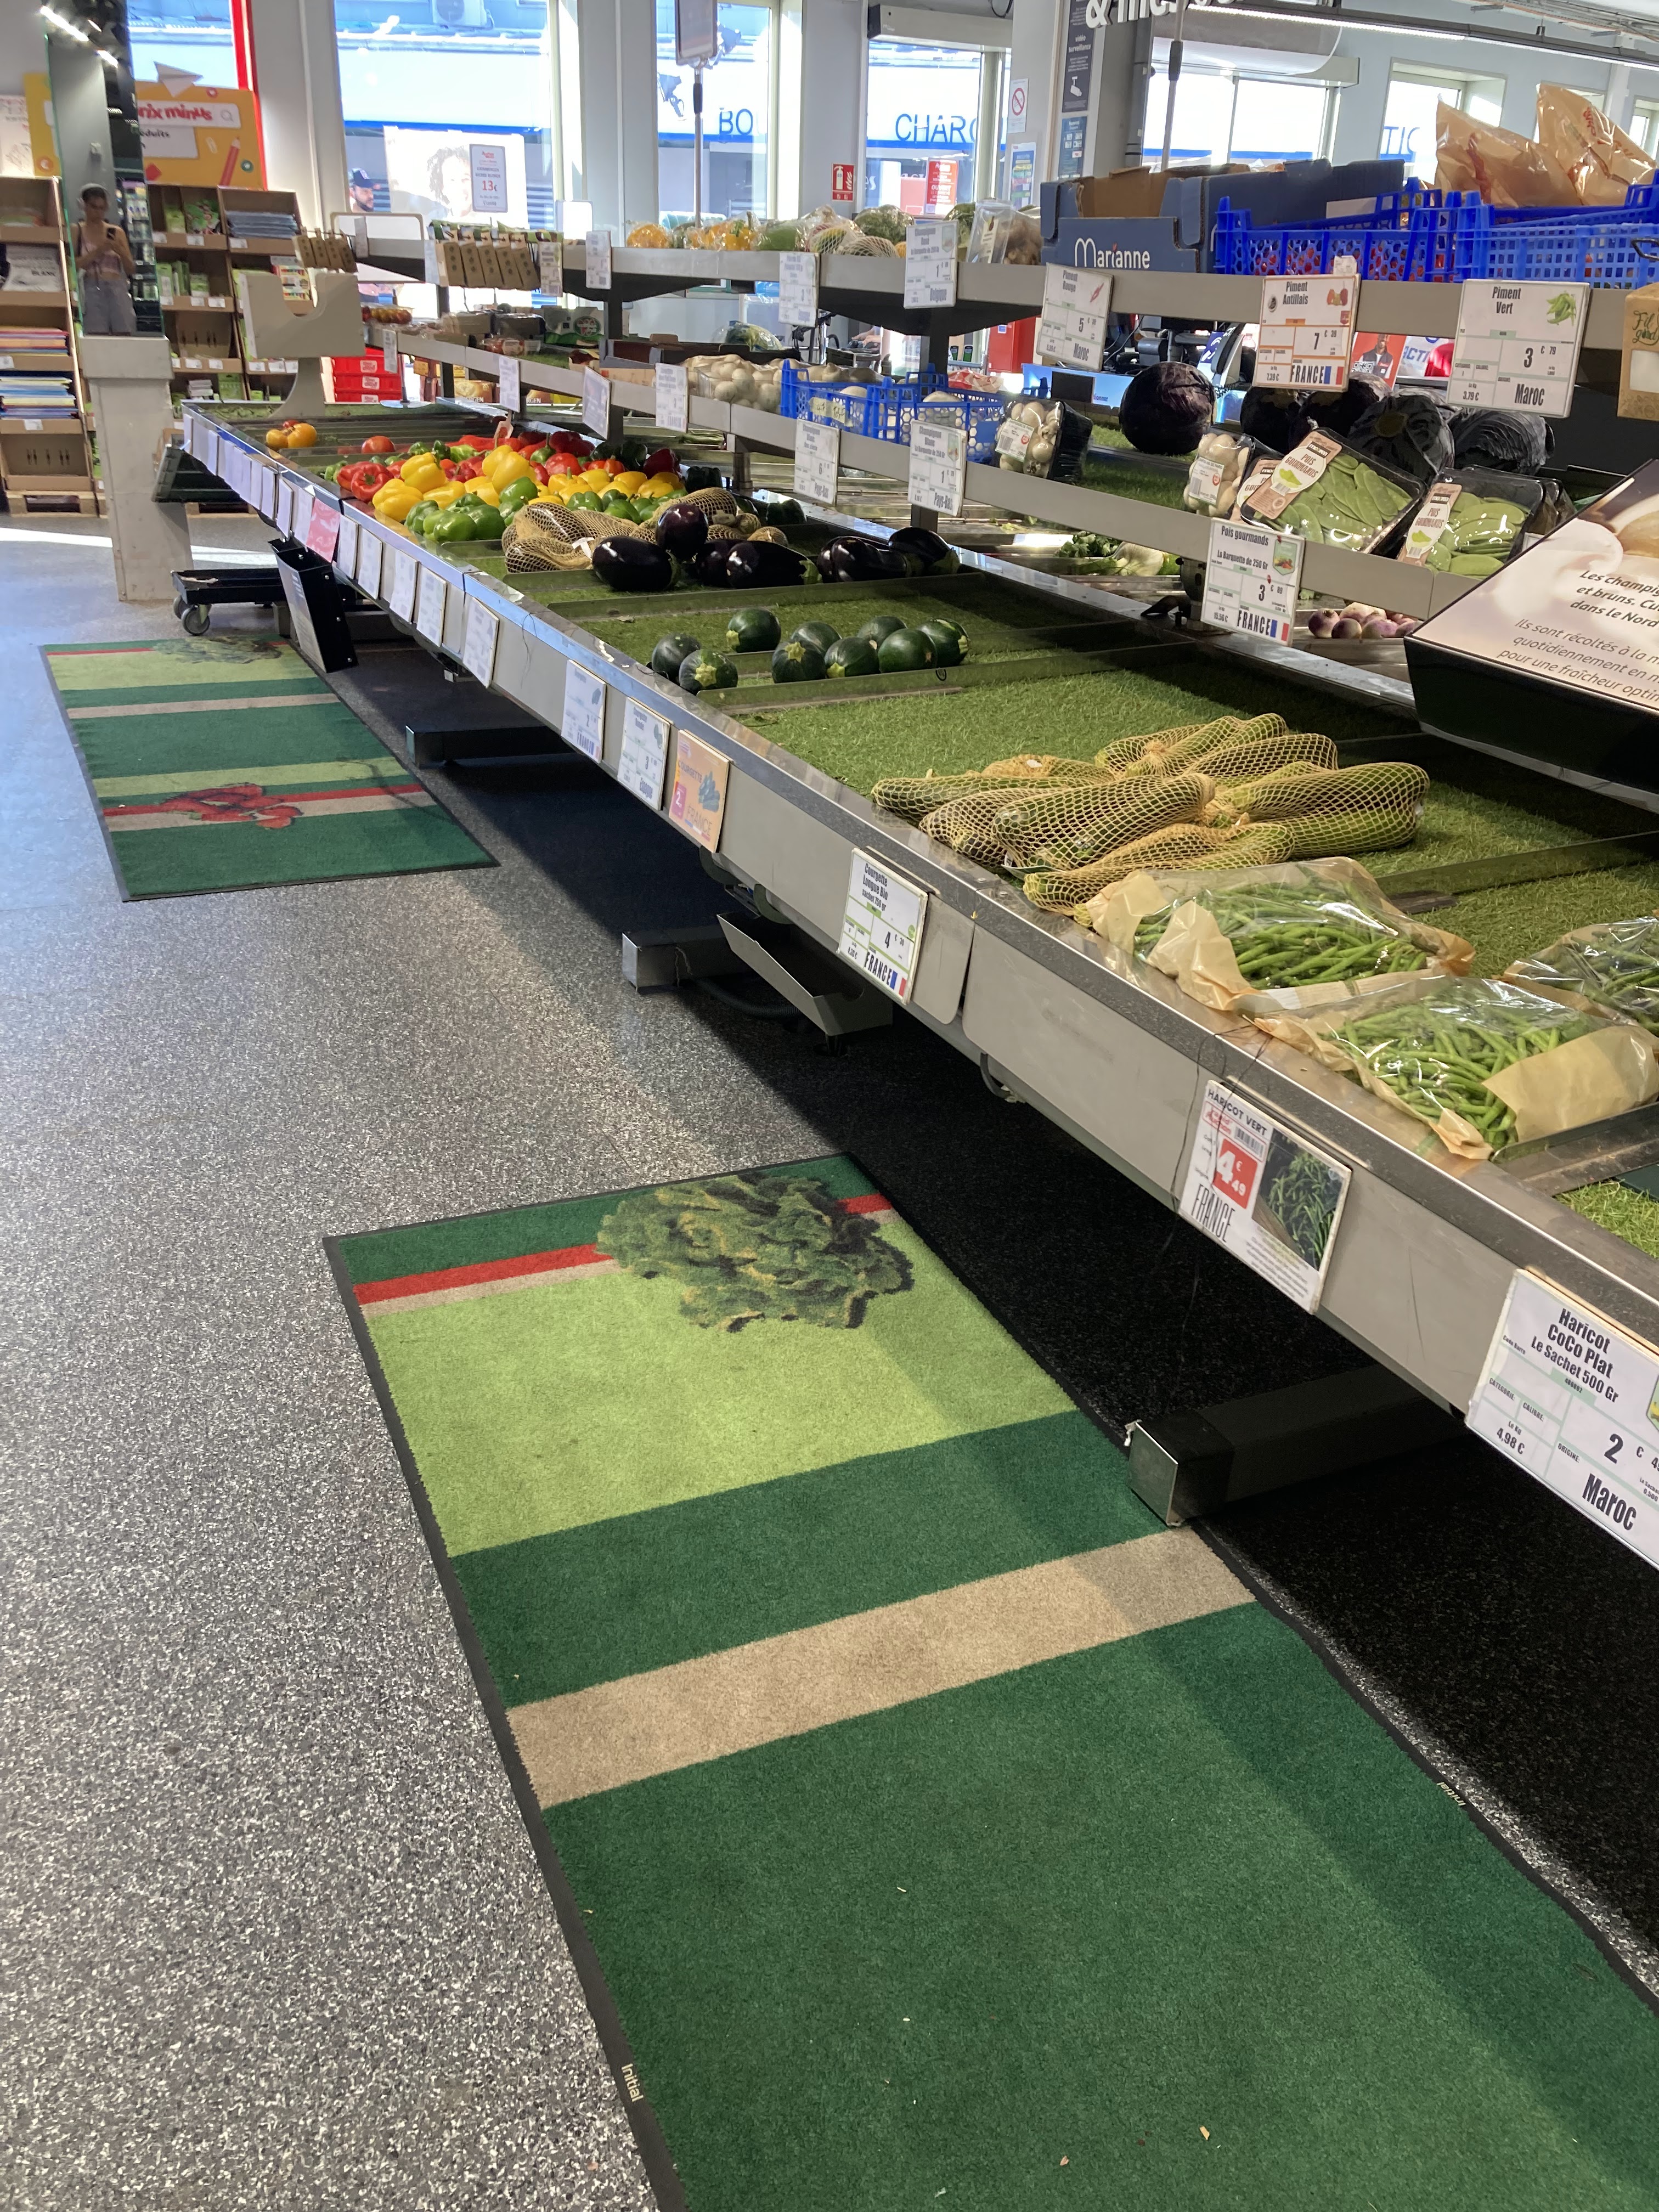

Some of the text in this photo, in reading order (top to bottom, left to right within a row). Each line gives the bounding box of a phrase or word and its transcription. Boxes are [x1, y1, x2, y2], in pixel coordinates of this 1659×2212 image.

[1074, 238, 1150, 269] Marianne
[1063, 269, 1078, 282] Piment
[1062, 280, 1076, 293] Rouge
[1285, 281, 1308, 292] Piment
[1492, 286, 1521, 300] Piment
[1283, 294, 1308, 305] Antillais
[1496, 301, 1514, 315] Vert
[1079, 318, 1085, 332] 5
[1313, 332, 1319, 350] 7
[1073, 342, 1090, 362] Maroc
[1523, 347, 1533, 368] 3
[1549, 346, 1556, 355] 79
[1290, 365, 1324, 384] FRANCE
[1514, 383, 1545, 406] Maroc
[919, 425, 942, 439] Champignon
[819, 462, 823, 475] 6
[1284, 456, 1319, 478] GOURMANDS
[1300, 453, 1317, 466] POIS
[941, 470, 945, 483] 1
[934, 492, 953, 510] Pays-Bas
[1221, 525, 1269, 546] Pois gourmands
[1217, 549, 1222, 558] La
[1223, 551, 1246, 565] Barquette
[1246, 556, 1252, 566] de
[1252, 558, 1262, 568] 250
[1262, 561, 1268, 570] Gr
[1579, 570, 1605, 582] Les
[1259, 584, 1266, 601] 3
[1577, 586, 1593, 595] et
[1592, 588, 1635, 605] bruns.
[1237, 610, 1271, 636] FRANCE
[1570, 600, 1659, 628] dans le Nord
[1514, 618, 1533, 629] Ils
[1532, 624, 1564, 638] sont
[1564, 633, 1618, 652] récoltés
[1618, 646, 1630, 656] à
[1630, 648, 1646, 661] la
[1513, 636, 1628, 673] quotidiennement
[1628, 668, 1647, 679] en
[1497, 650, 1622, 690] pour une fraîcheur
[645, 756, 649, 770] 3
[678, 759, 703, 783] COURGETTE
[675, 791, 681, 807] 2
[687, 805, 713, 836] FRANCE
[865, 862, 888, 888] Courgette
[862, 873, 888, 901] Longue Bio
[884, 931, 891, 949] 4
[864, 951, 892, 986] FRANCE
[1208, 1088, 1267, 1136] HARICOT VERT
[1216, 1150, 1246, 1197] 4 € 49
[1190, 1183, 1236, 1243] FRANCE
[1558, 1307, 1611, 1355] Haricot
[1548, 1323, 1614, 1379] CoCo Plat
[1531, 1335, 1620, 1403] Le Sachet 500 Gr
[1508, 1420, 1515, 1429] Le
[1604, 1433, 1624, 1464] 2
[1582, 1472, 1637, 1531] Maroc
[621, 2063, 644, 2103] Initial
